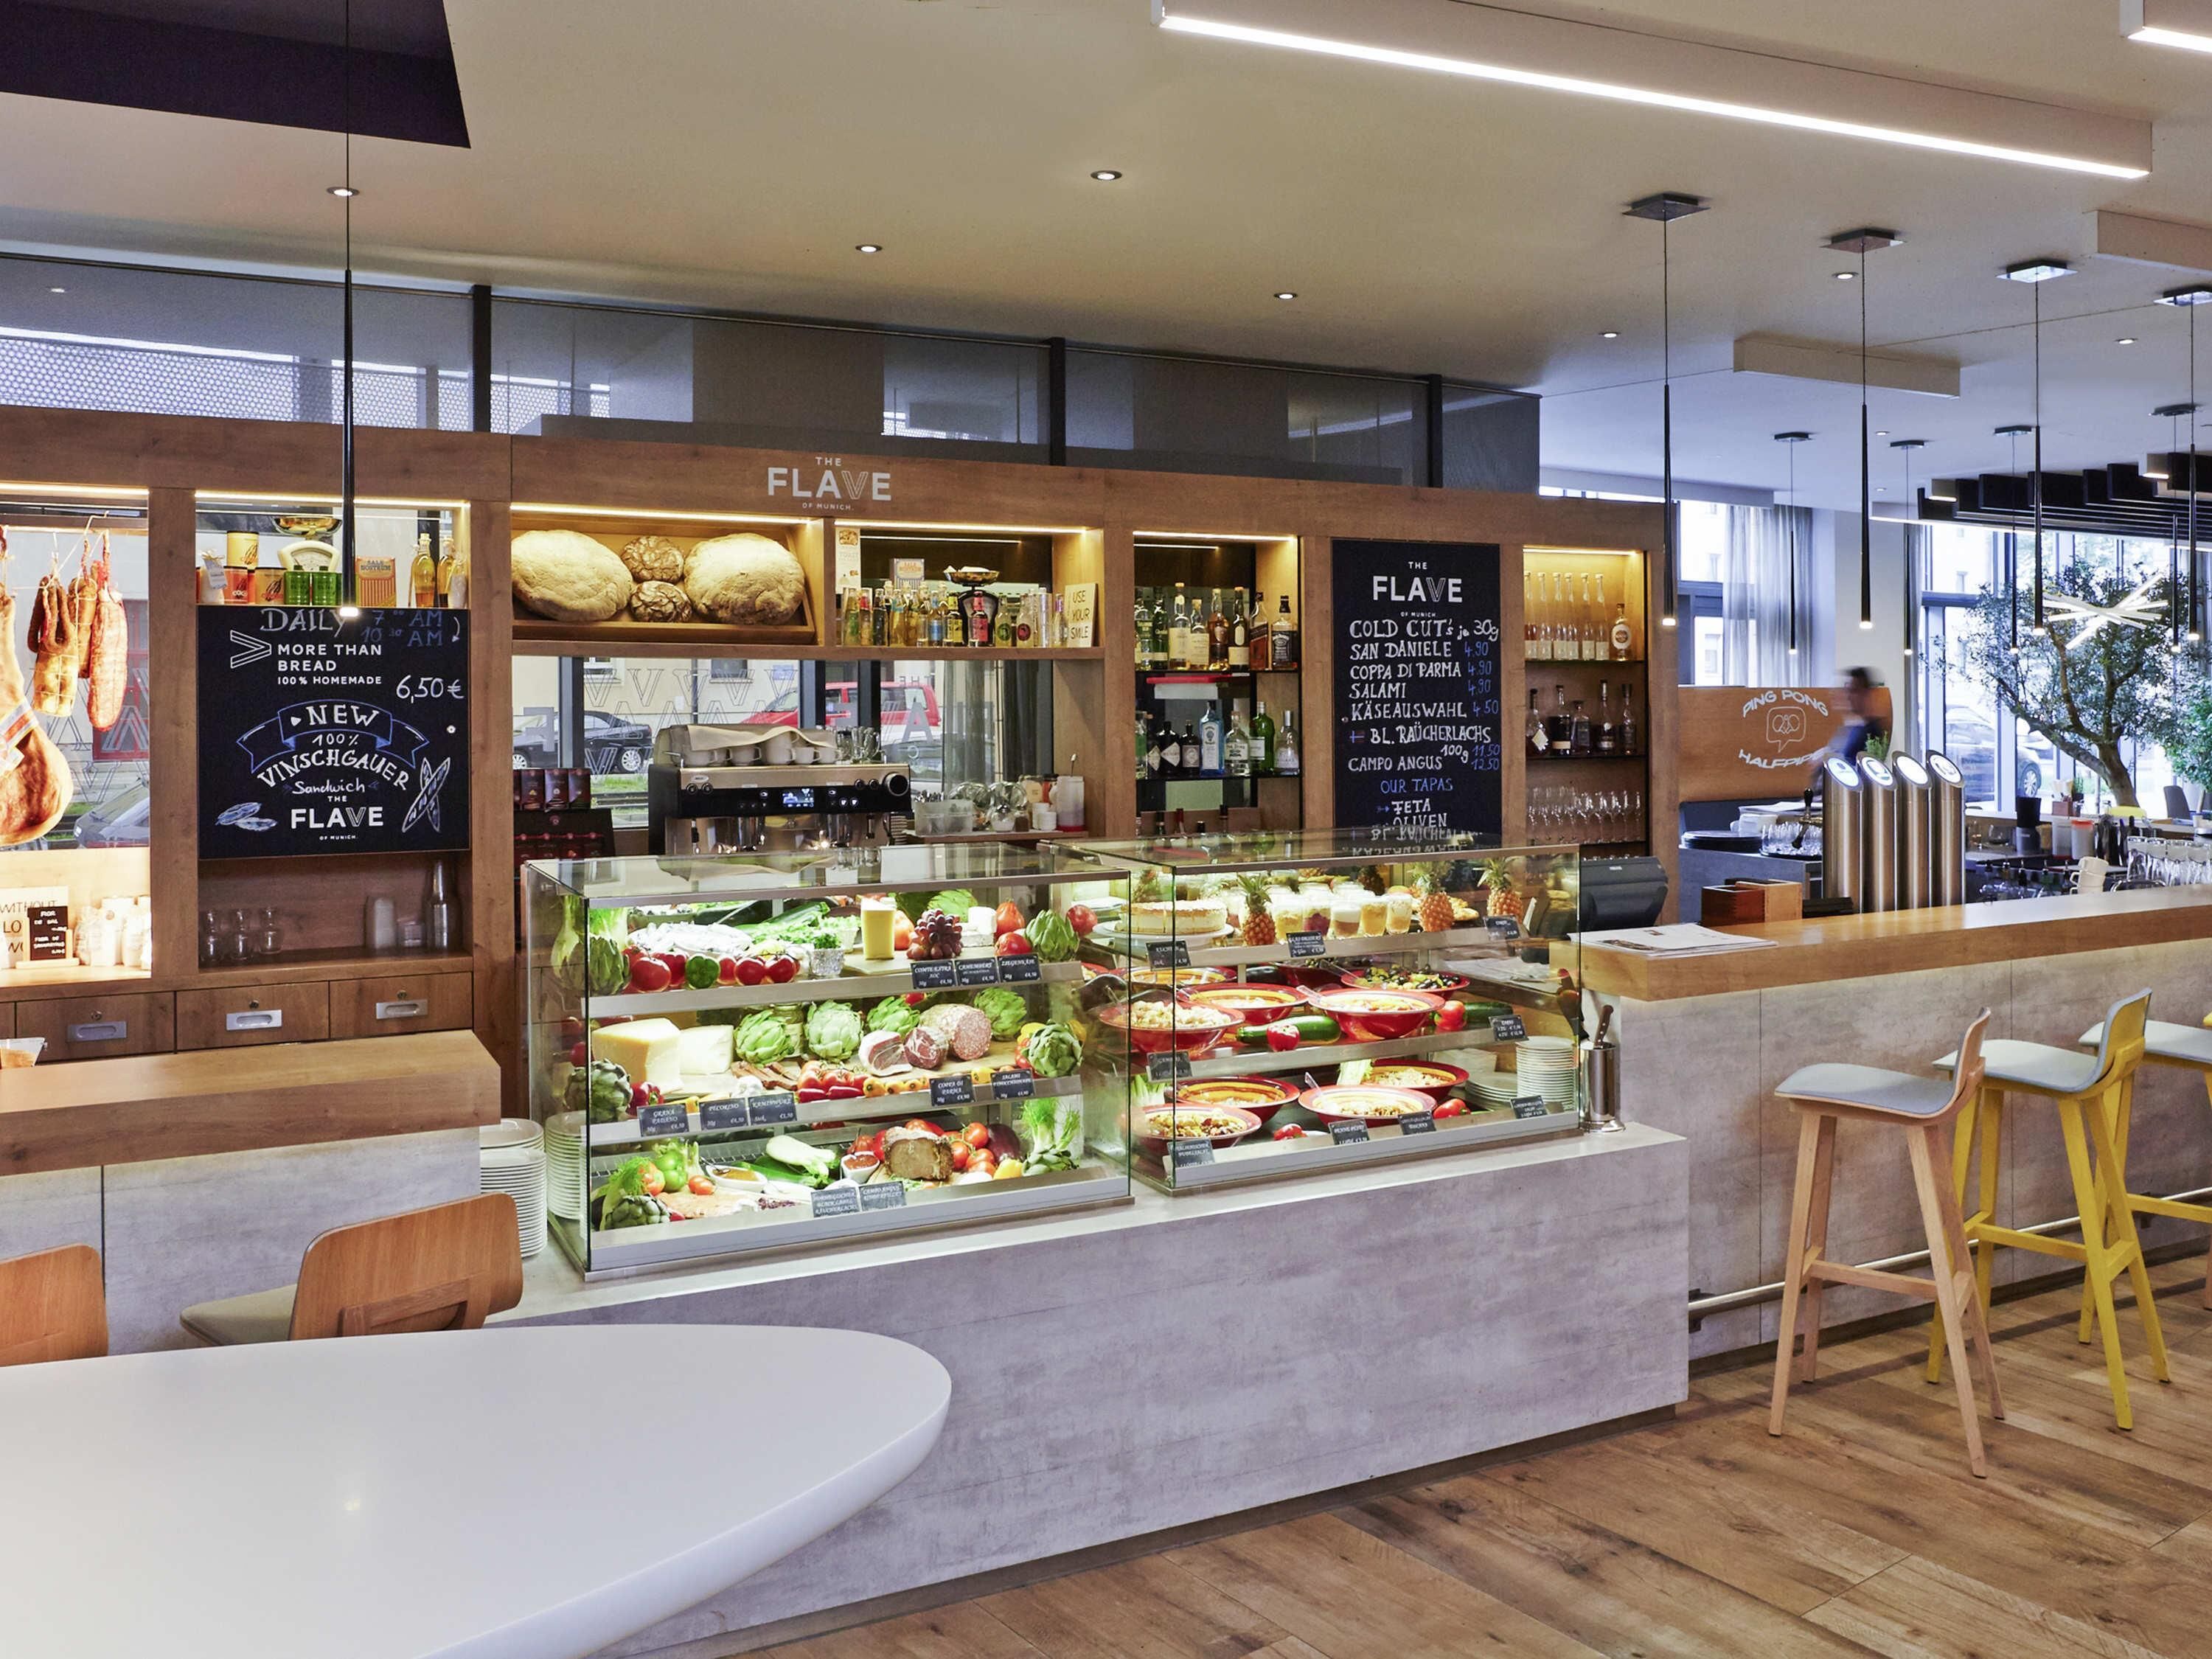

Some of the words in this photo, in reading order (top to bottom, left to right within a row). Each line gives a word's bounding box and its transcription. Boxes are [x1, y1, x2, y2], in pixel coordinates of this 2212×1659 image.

[815, 456, 841, 467] THE
[768, 467, 891, 501] FLAVE
[1408, 561, 1428, 570] THE
[1073, 590, 1086, 603] USE
[1372, 575, 1463, 603] FLAVE
[260, 608, 347, 638] DAILY
[408, 609, 442, 627] AM
[1072, 608, 1090, 621] YOUR
[361, 627, 382, 644] 10
[406, 630, 442, 647] AM
[1071, 625, 1088, 639] SMILE
[1349, 619, 1398, 639] COLD
[1473, 619, 1499, 641] 30g
[277, 644, 327, 655] MORE
[334, 644, 382, 655] THAN
[1349, 642, 1379, 661] SAN
[1384, 640, 1452, 658] DANIELE
[277, 661, 337, 672] BREAD
[1349, 664, 1392, 681] COPPA
[1397, 663, 1412, 678] DI
[1416, 662, 1461, 678] PARMA
[313, 676, 382, 685] HOMEMADE
[1349, 682, 1406, 699] SALAMI
[1352, 700, 1467, 721] KÄSEAUSWAHL
[1742, 691, 1777, 718] PING
[1781, 689, 1829, 717] PONG
[305, 703, 380, 726] NEW
[1440, 745, 1470, 764] 100g
[257, 749, 409, 790] VINSCHGAUER
[1348, 757, 1393, 772] CAMPO
[1397, 756, 1443, 771] ANGUS
[292, 779, 366, 794] Sandwich
[1380, 779, 1407, 793] OUR
[1411, 778, 1453, 793] TAPAS
[327, 795, 348, 803] THE
[1391, 798, 1431, 815] FETA
[291, 806, 384, 830] FLAVE
[3, 920, 21, 933] LO
